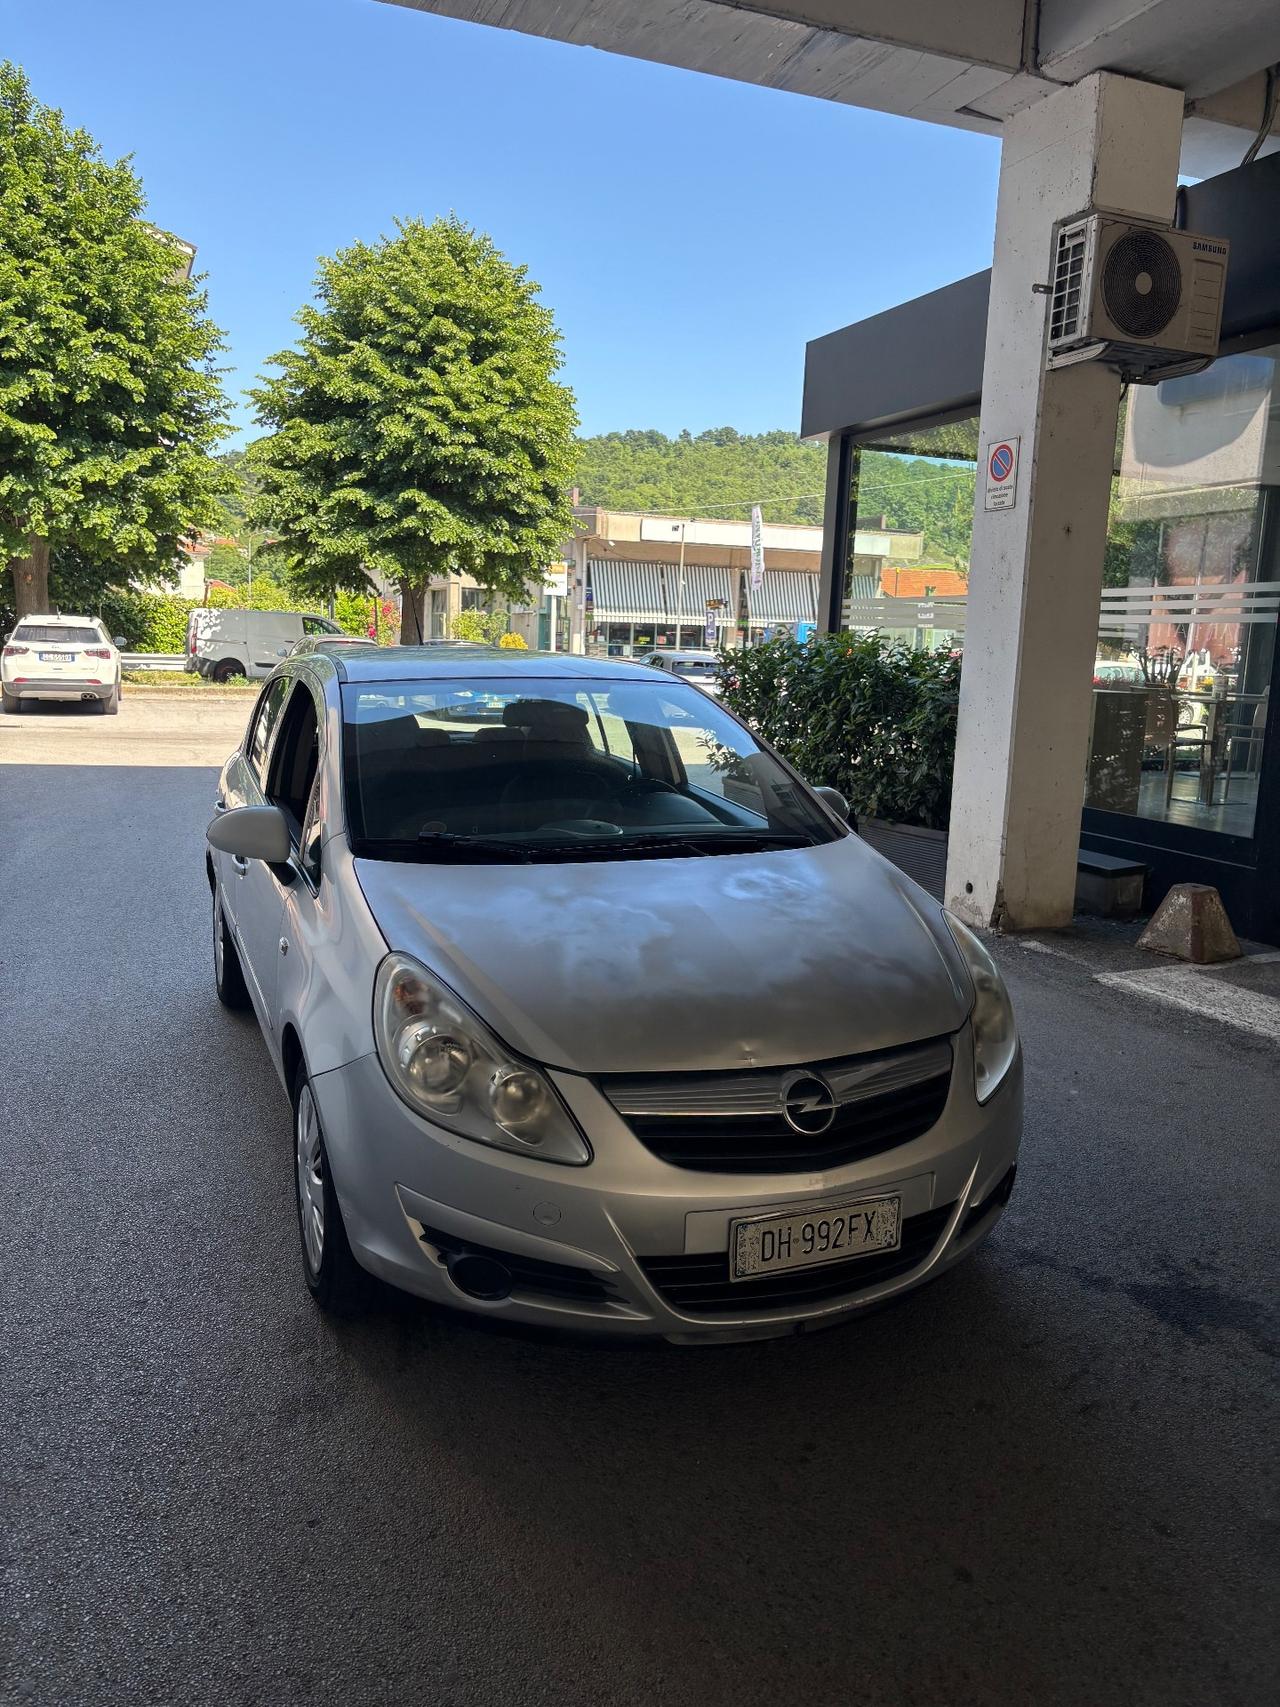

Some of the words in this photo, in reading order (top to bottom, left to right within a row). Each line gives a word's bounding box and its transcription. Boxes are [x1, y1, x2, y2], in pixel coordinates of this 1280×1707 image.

[1192, 242, 1227, 255] SAMSUNG
[708, 614, 713, 625] P
[761, 1227, 792, 1262] DH
[801, 1210, 876, 1254] 992FX
